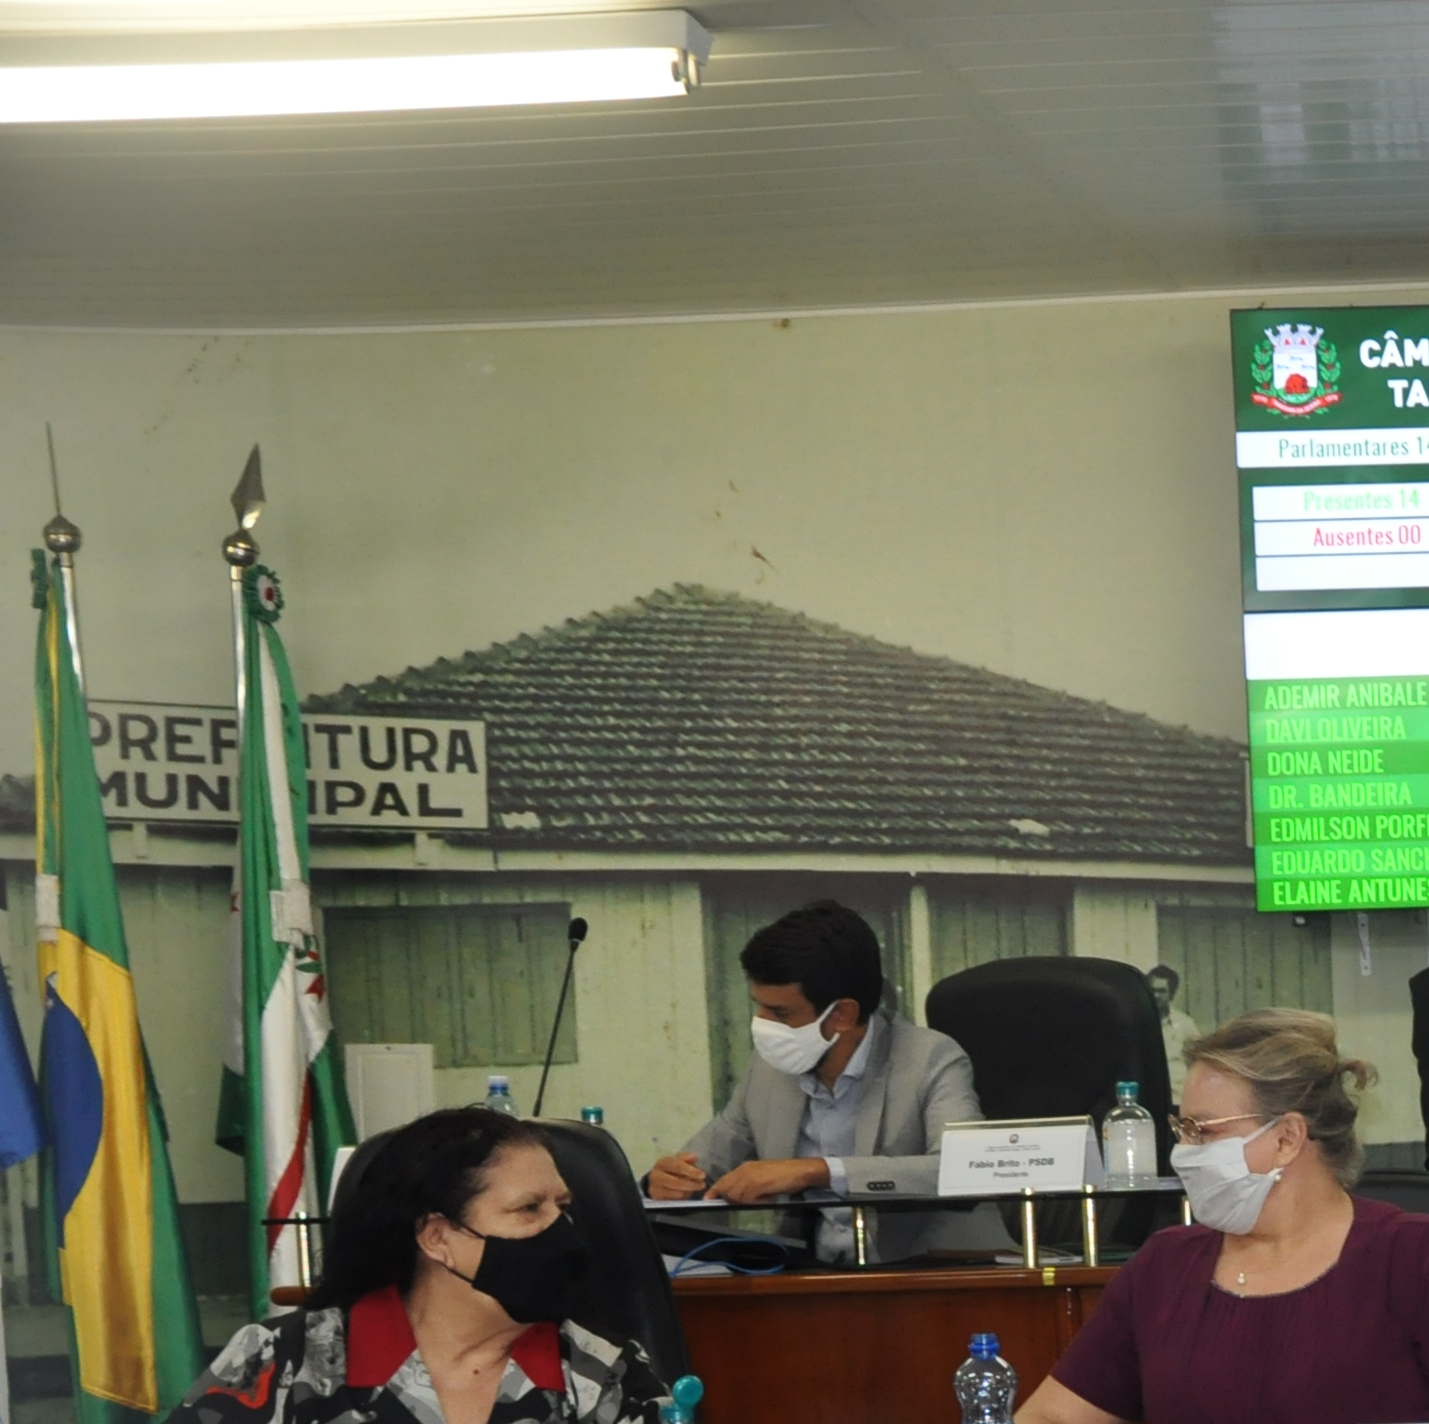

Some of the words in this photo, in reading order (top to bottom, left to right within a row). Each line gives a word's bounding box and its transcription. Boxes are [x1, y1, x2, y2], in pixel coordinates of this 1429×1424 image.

[1278, 436, 1409, 459] Parlamentares
[1303, 489, 1393, 512] Presentes
[1399, 487, 1420, 509] 14
[1313, 526, 1394, 548] Ausentes
[1398, 524, 1421, 545] 00
[1265, 684, 1340, 711] ADEMIR
[1346, 681, 1428, 707] ANIBALE
[88, 710, 478, 774] PREFITURA
[1266, 717, 1313, 744] DAVI
[1317, 714, 1407, 742] OLIVEIRA
[1267, 750, 1322, 776] DONA
[1327, 748, 1384, 774] NEIDE
[98, 770, 464, 818] MUNIPAL
[1269, 783, 1303, 809] DR.
[1309, 781, 1412, 807] BANDEIRA
[1270, 815, 1370, 842] EDMILSON
[1272, 848, 1365, 875] EDUARDO
[1273, 880, 1342, 906] ELAINE
[998, 1158, 1021, 1168] Brito
[1029, 1157, 1055, 1167] PSDB
